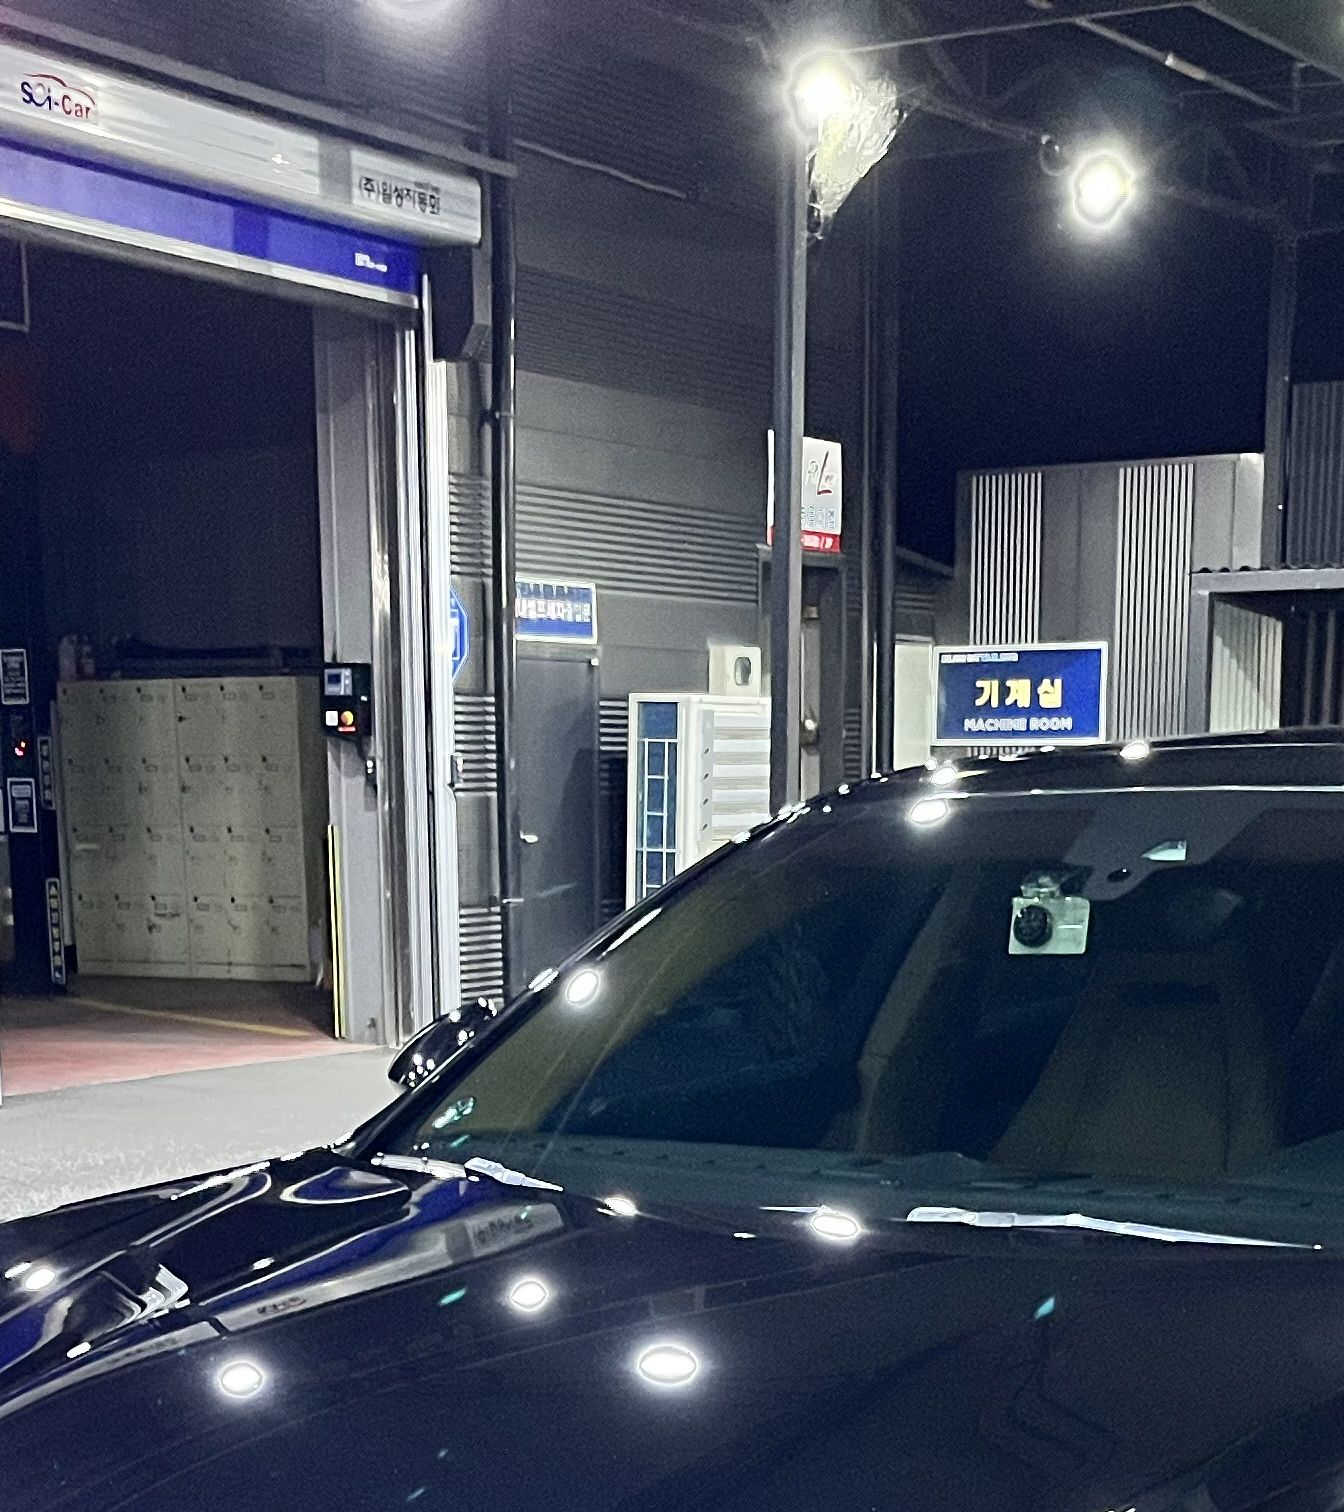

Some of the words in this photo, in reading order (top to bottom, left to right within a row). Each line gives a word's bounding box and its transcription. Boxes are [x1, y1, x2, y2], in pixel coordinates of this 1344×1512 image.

[975, 678, 1062, 708] 기계실
[964, 717, 1027, 732] MACHINE
[1030, 717, 1072, 731] ROOM
